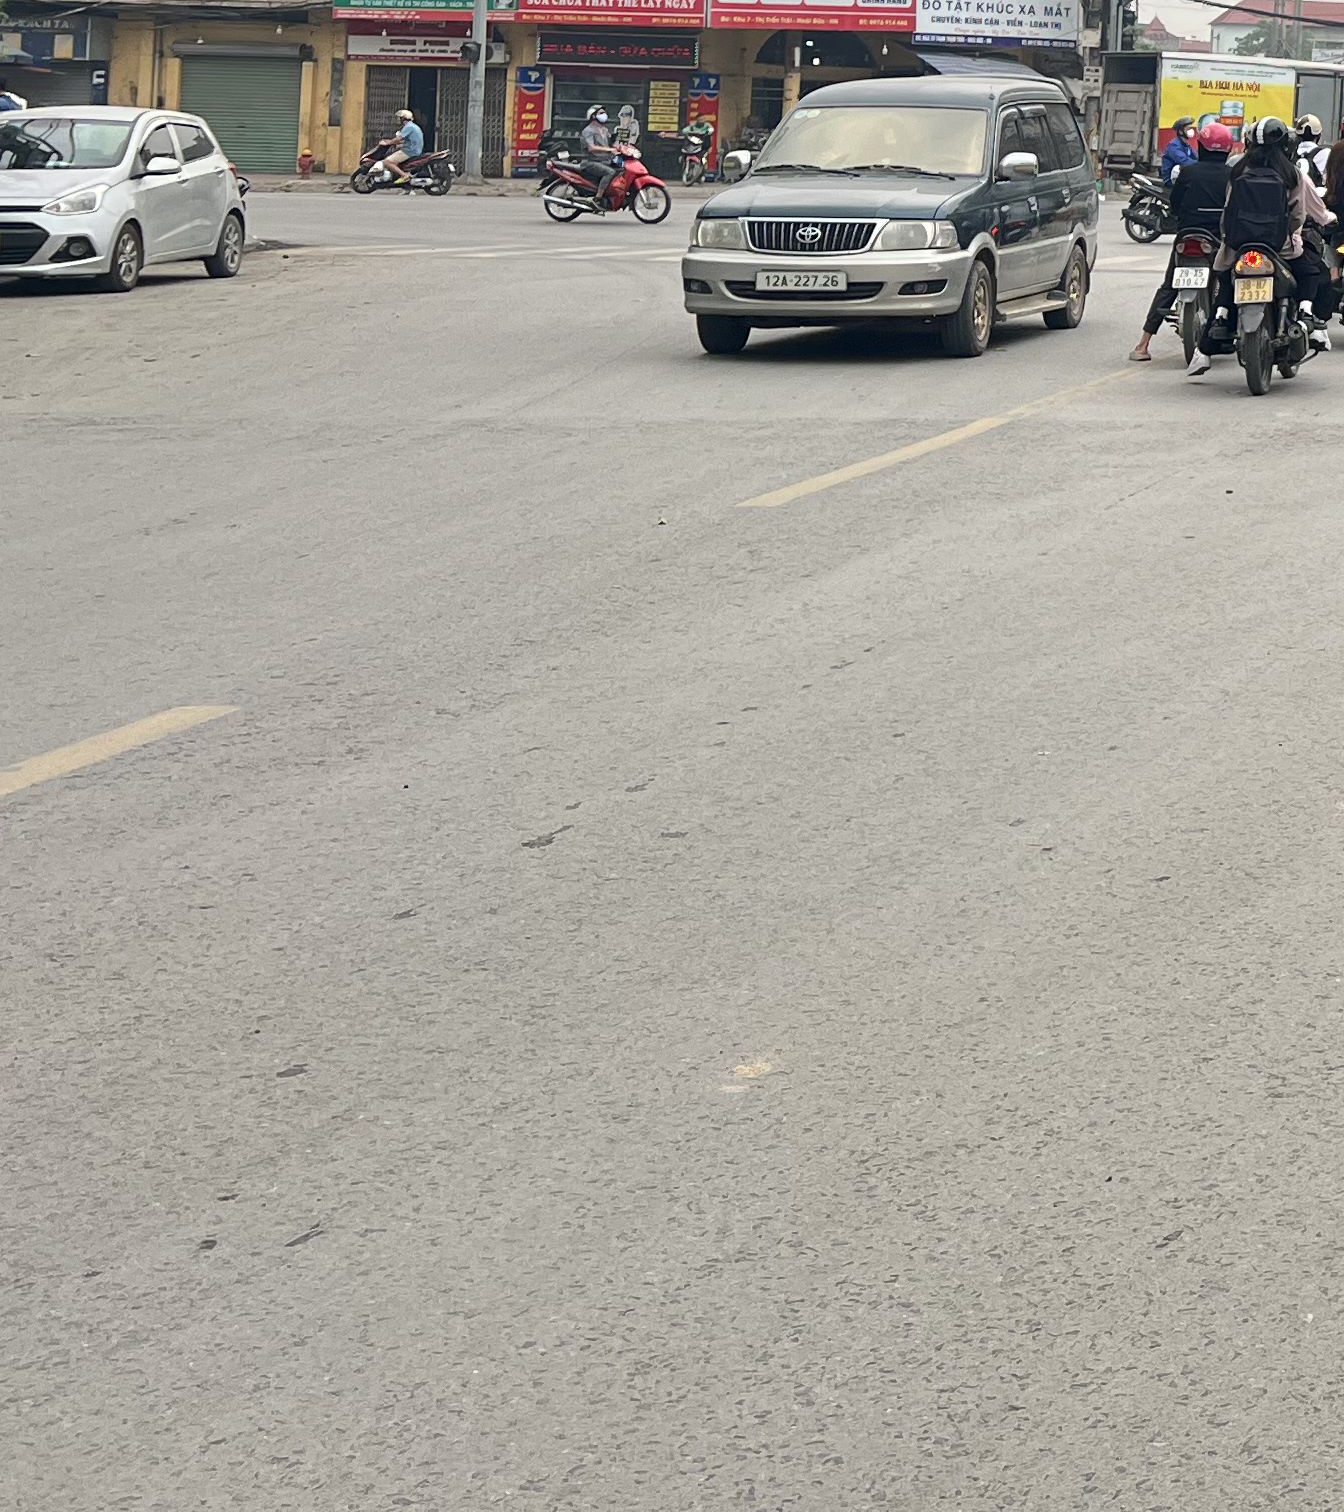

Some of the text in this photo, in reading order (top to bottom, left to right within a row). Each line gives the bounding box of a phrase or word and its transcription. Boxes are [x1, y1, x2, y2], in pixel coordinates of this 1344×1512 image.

[922, 0, 942, 10] ĐO
[976, 0, 1014, 15] KHÚC
[1018, 5, 1036, 16] XẠ
[1043, 2, 1072, 18] MẮT
[1232, 79, 1244, 91] HÀ
[1246, 81, 1261, 94] NỘI
[1240, 291, 1267, 302] 2332
